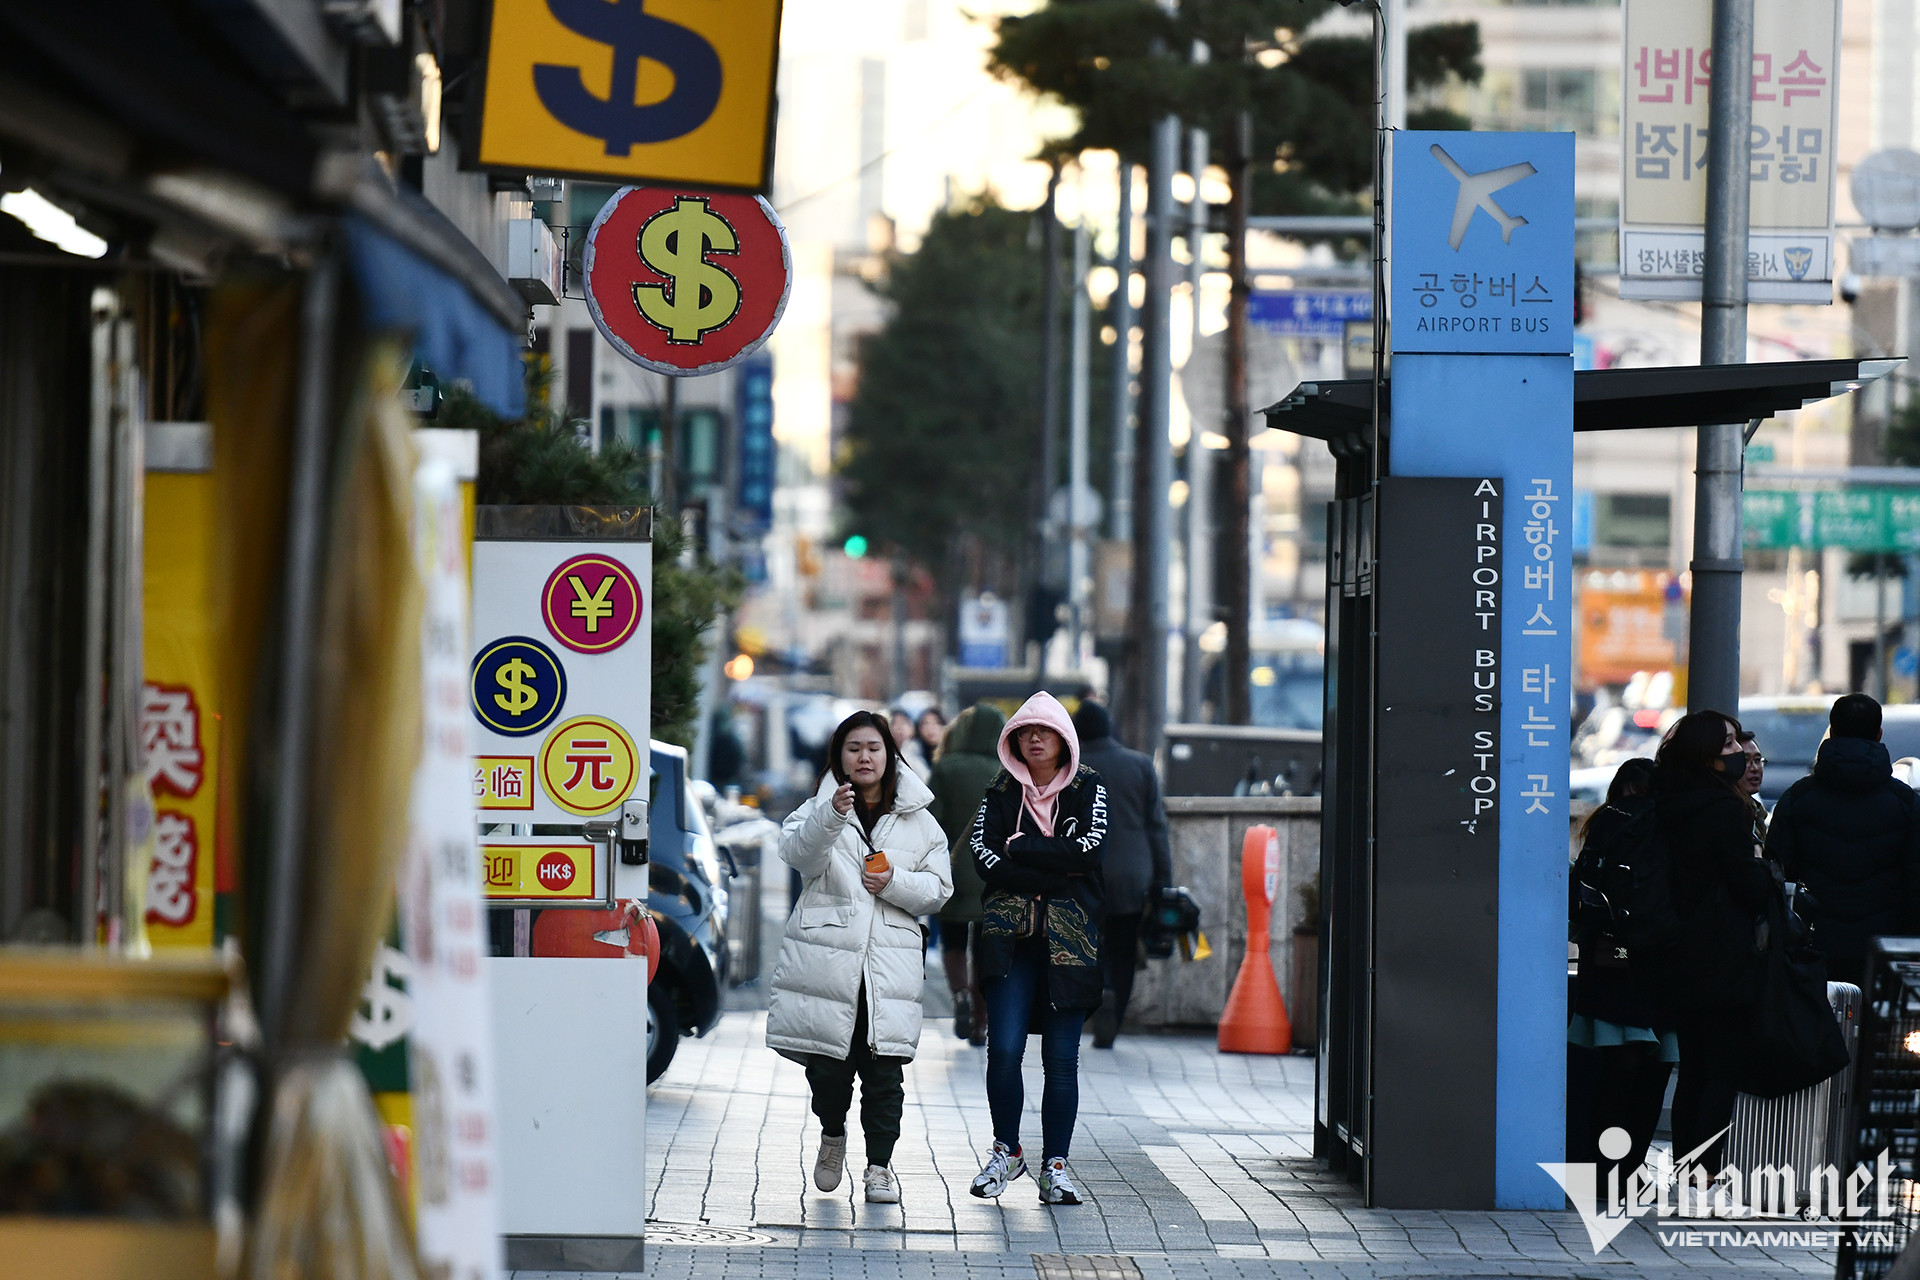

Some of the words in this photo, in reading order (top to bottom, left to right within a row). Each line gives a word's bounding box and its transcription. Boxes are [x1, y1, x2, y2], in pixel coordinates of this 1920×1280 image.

[633, 197, 743, 344] $
[1413, 272, 1553, 308] 공항버스
[1417, 317, 1502, 332] AIRPORT
[1511, 317, 1549, 333] BUS
[1473, 479, 1498, 630] AIRPORT
[1523, 479, 1559, 635] 공항버스
[493, 657, 539, 716] $
[1474, 650, 1496, 712] BUS
[1521, 664, 1556, 746] 타는
[563, 741, 615, 791] 元
[1470, 731, 1494, 815] STOP
[1520, 774, 1555, 814] 곳
[483, 855, 513, 886] 迎
[540, 864, 572, 880] HK$
